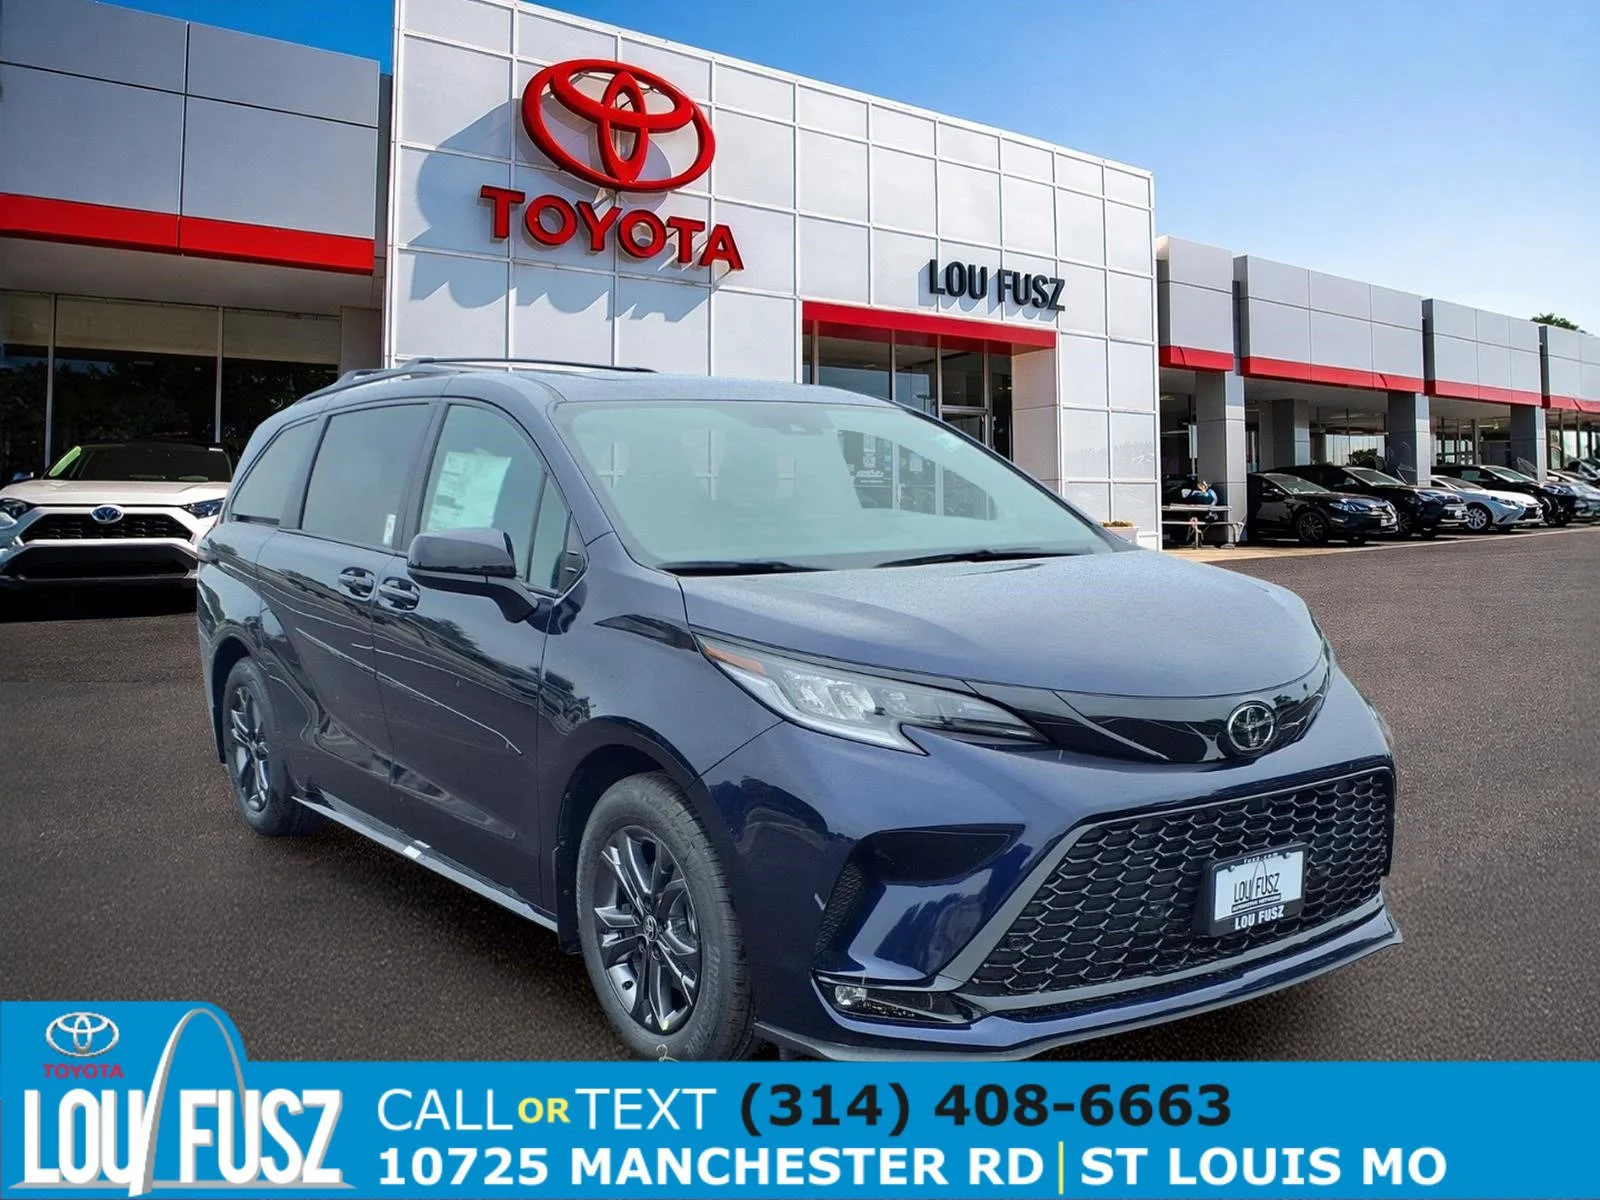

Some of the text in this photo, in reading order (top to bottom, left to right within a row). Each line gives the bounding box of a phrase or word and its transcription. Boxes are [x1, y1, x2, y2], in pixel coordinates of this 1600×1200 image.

[480, 184, 744, 270] TOYOTA
[929, 259, 1065, 312] LOU FUSZ
[1234, 879, 1254, 903] LOU
[1255, 873, 1280, 897] FUSZ
[1235, 905, 1284, 930] LOU FUSZ
